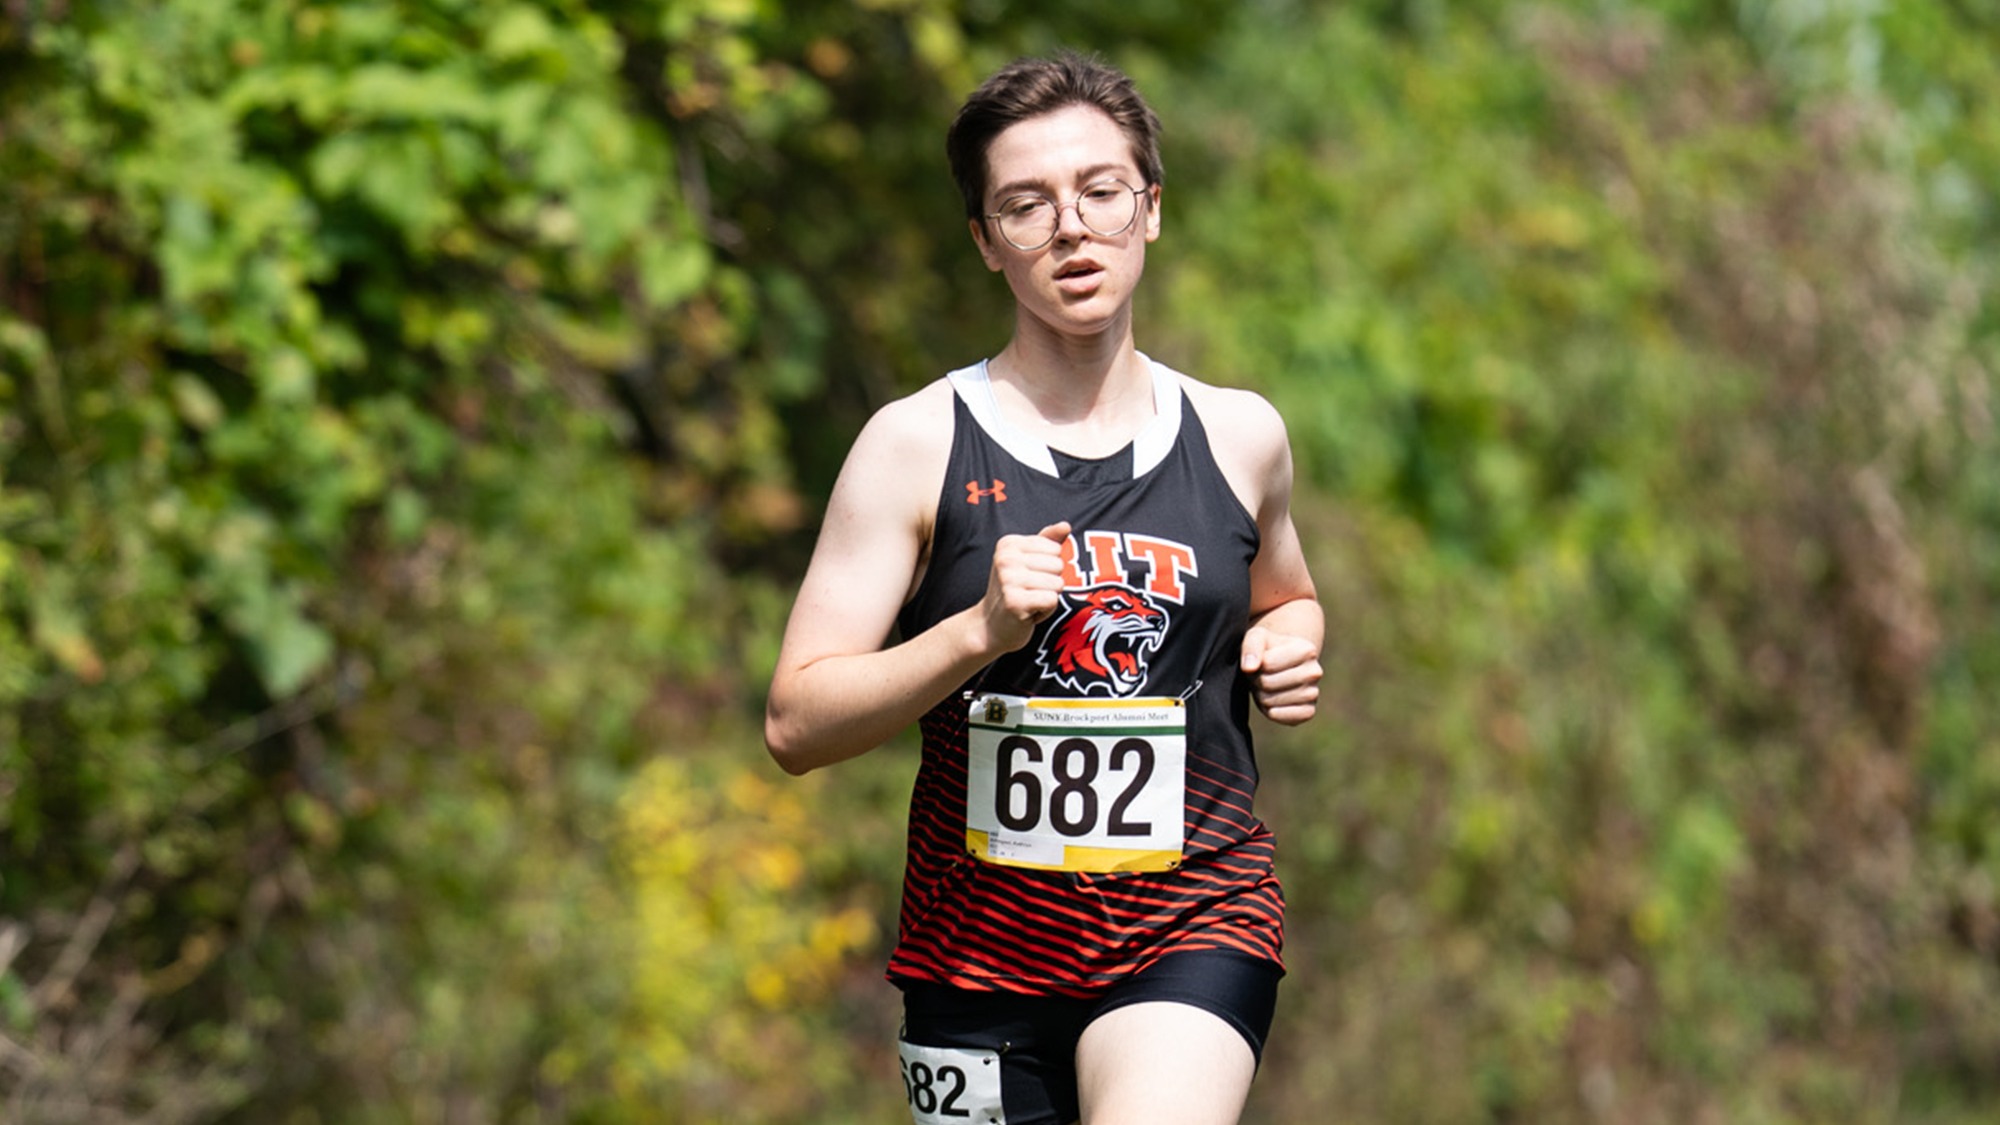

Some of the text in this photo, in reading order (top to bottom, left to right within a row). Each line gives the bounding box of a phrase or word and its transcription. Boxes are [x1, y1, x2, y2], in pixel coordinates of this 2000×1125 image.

[1033, 712, 1169, 723] SUNY Brockport Alumni Meet
[995, 735, 1156, 837] 682
[899, 1054, 970, 1118] 82
